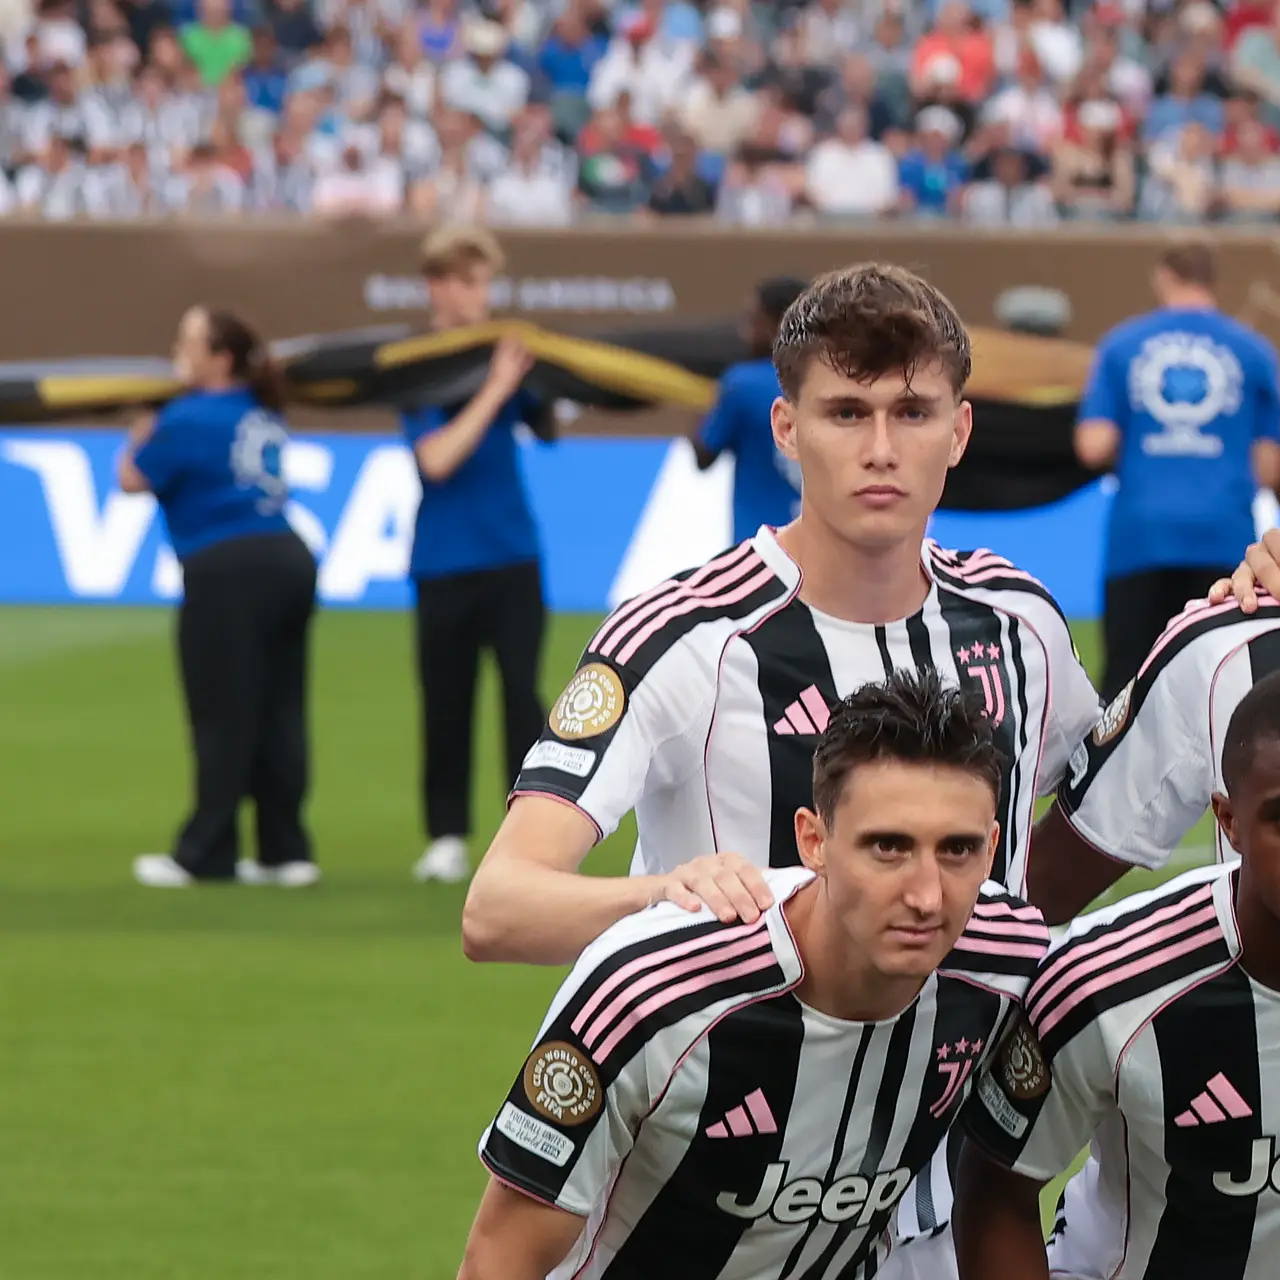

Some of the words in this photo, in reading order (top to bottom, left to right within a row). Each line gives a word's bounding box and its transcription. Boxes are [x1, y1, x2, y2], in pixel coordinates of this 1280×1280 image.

[545, 1049, 578, 1066] WORLD
[579, 1065, 594, 1086] CUP
[536, 1090, 563, 1120] FIFA
[570, 1099, 591, 1116] USA
[715, 1161, 912, 1228] Jeep
